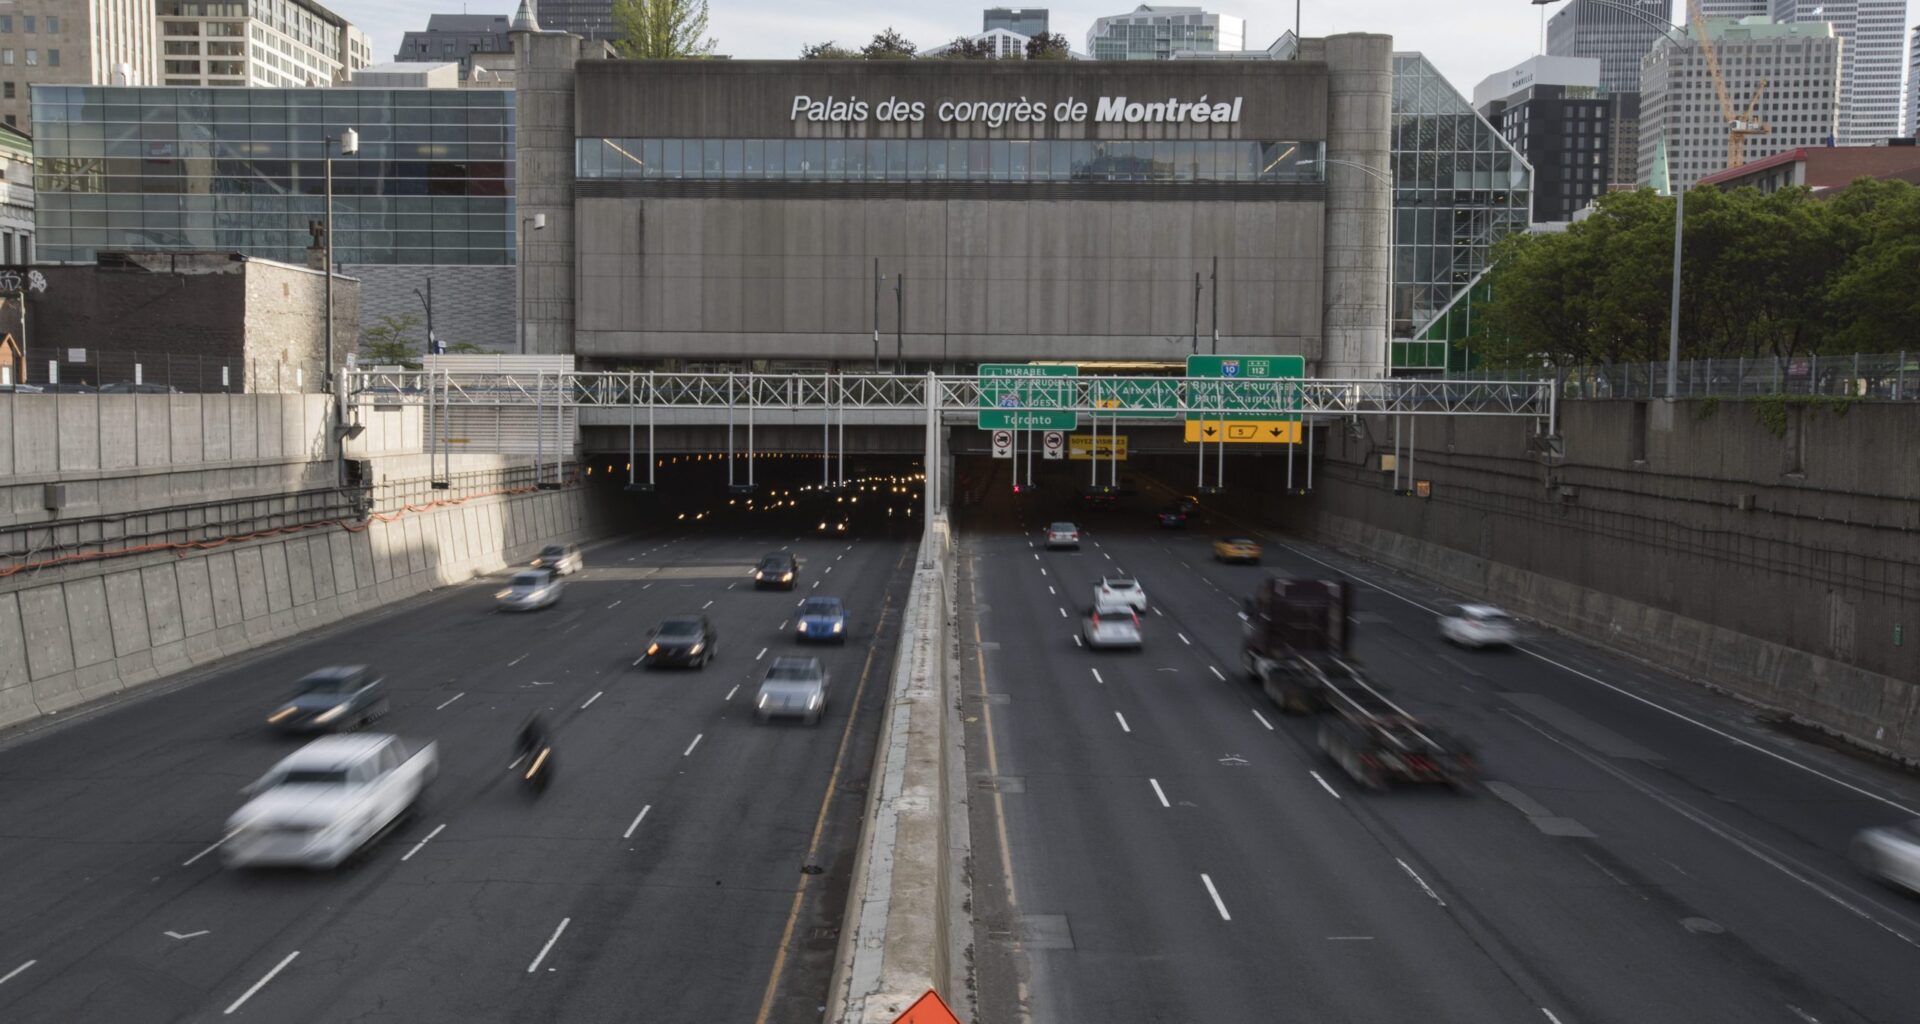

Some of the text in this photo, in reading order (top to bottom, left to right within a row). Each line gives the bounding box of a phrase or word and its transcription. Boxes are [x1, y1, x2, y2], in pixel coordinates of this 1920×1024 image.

[790, 94, 1242, 128] Palais des congrès de Montréal
[1005, 368, 1047, 376] MIRABEL
[1003, 416, 1052, 425] Toronto
